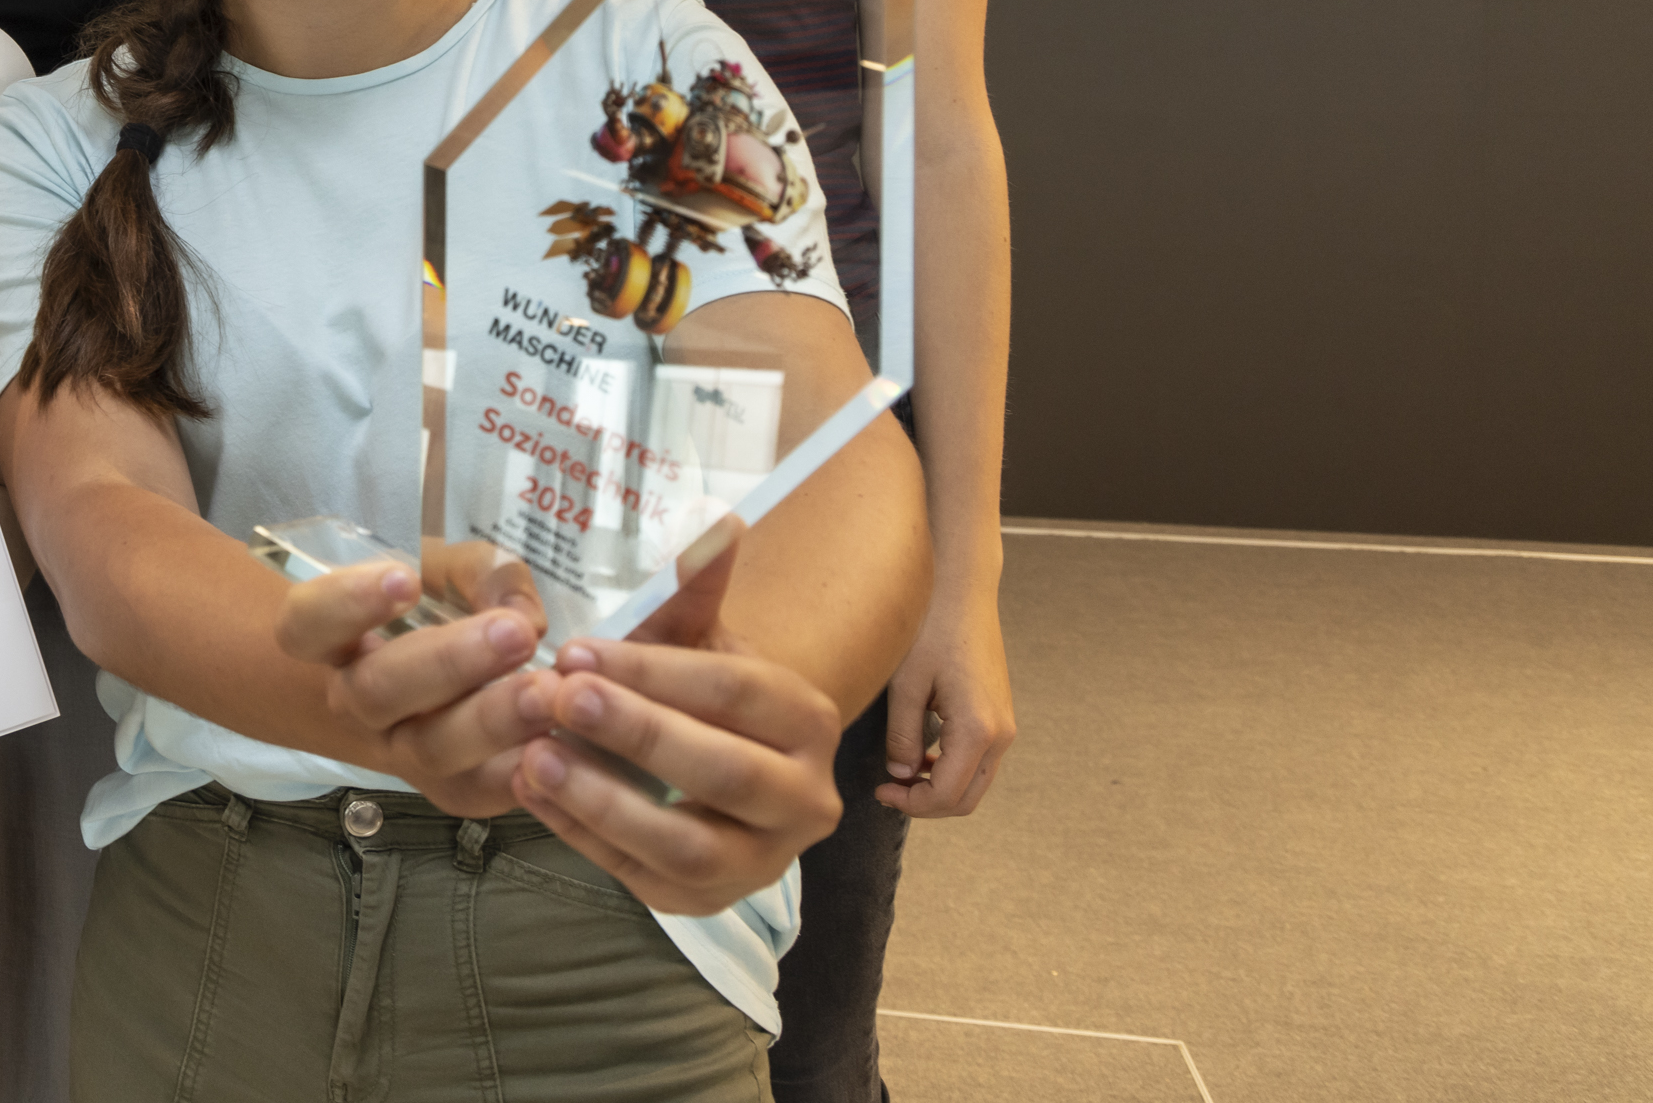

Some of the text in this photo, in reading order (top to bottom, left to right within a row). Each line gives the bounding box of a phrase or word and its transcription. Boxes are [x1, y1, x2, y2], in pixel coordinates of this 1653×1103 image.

[488, 316, 616, 395] MASCHINE
[502, 285, 608, 355] WUNDER
[499, 370, 683, 482] Sonderpreis
[477, 407, 670, 526] Soziotechnik
[517, 475, 594, 534] 2024
